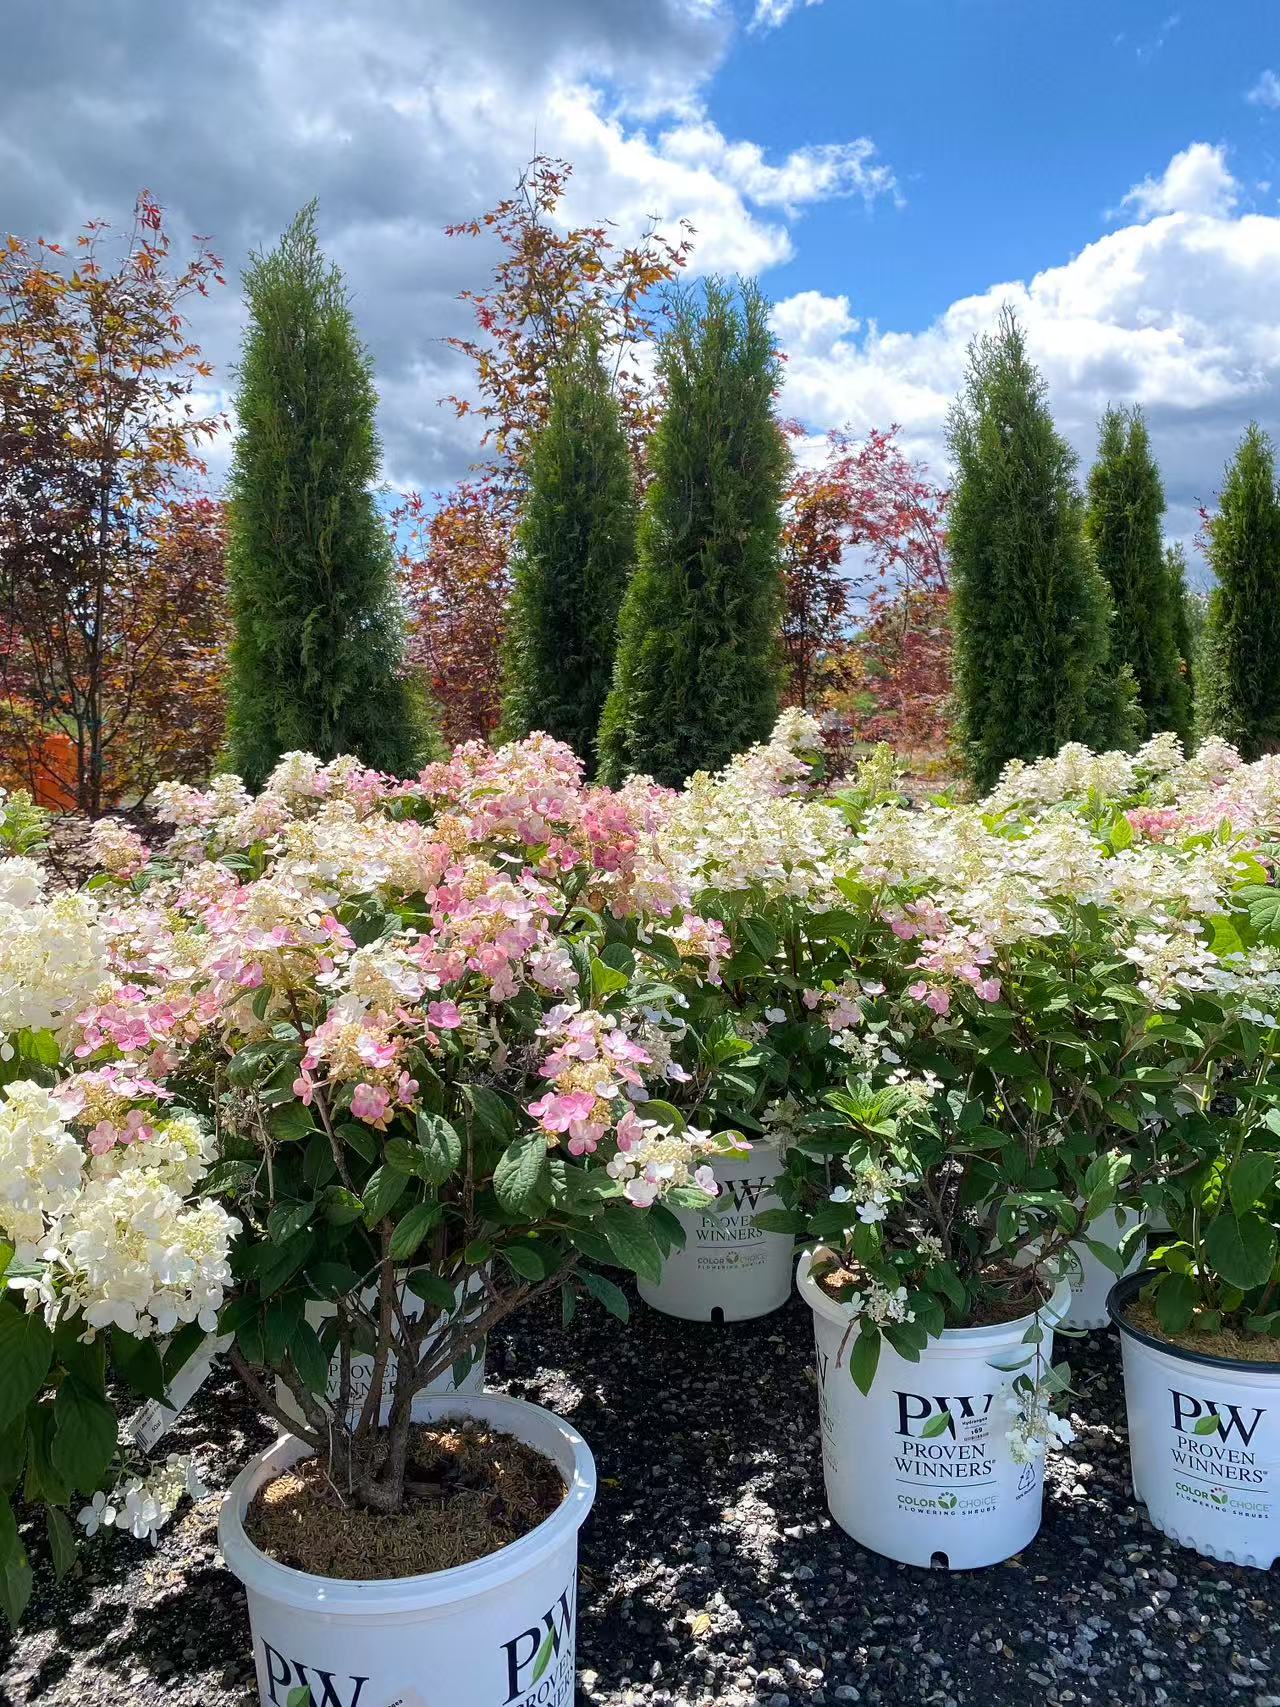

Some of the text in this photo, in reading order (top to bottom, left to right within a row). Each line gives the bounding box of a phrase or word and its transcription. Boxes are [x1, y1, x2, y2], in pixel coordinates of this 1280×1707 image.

[702, 1214, 757, 1227] POVE
[329, 1364, 400, 1379] POVEN
[892, 1390, 994, 1440] PW
[1168, 1388, 1267, 1447] PW
[902, 1440, 986, 1460] PROVEN
[1177, 1435, 1255, 1465] PROVEN
[898, 1495, 996, 1508] COLOR CHOICE
[1176, 1482, 1269, 1512] COLOR CHOICE
[1176, 1492, 1269, 1519] FLOWERING SHRUBS
[899, 1505, 997, 1515] FLOWERING SHRUBS
